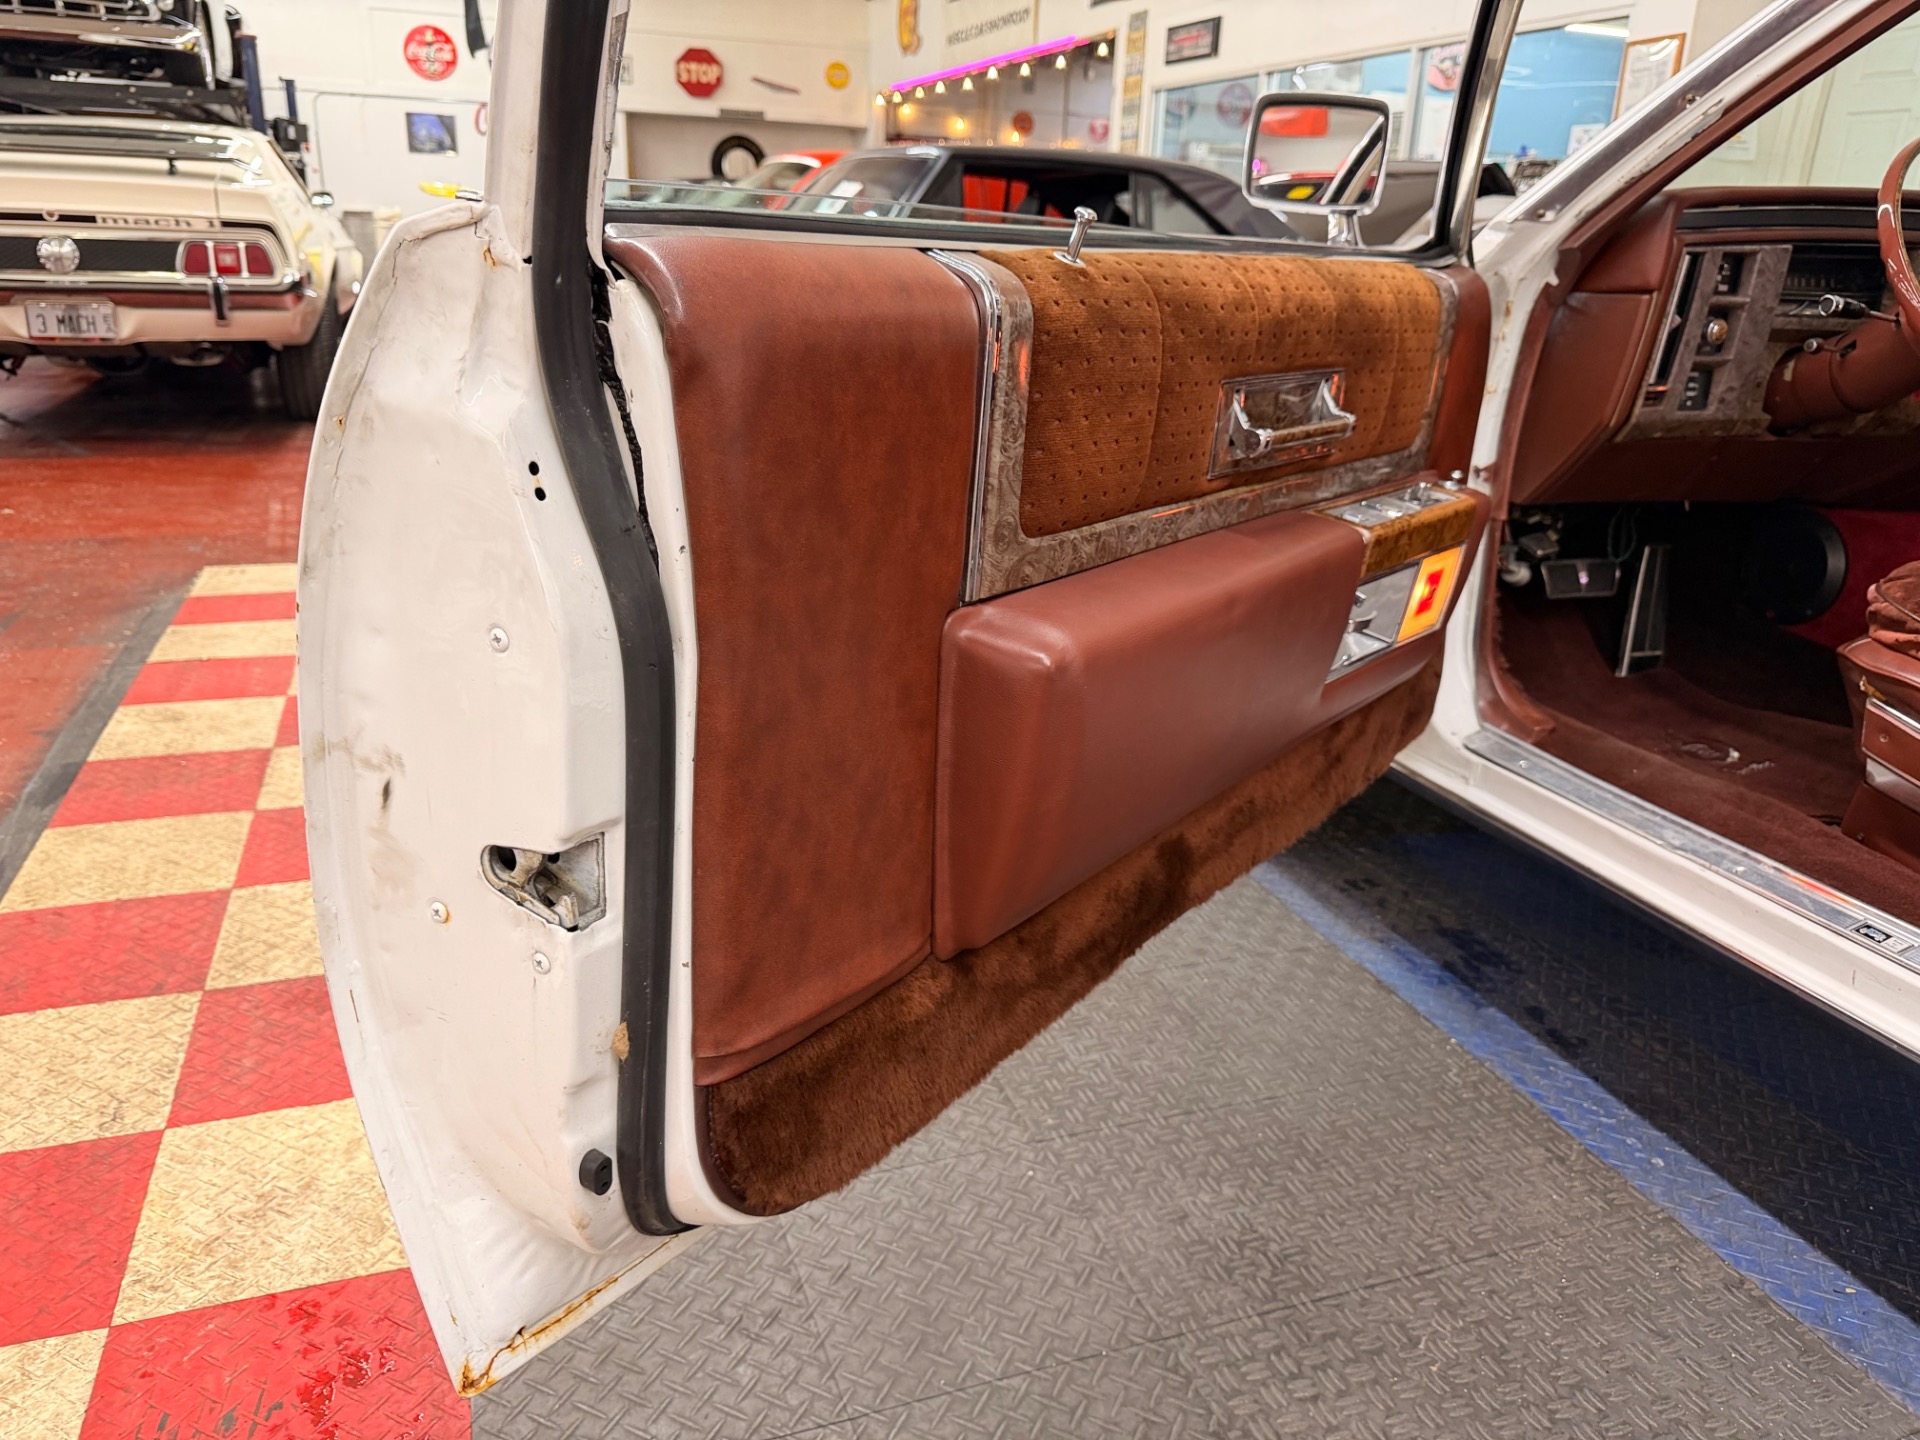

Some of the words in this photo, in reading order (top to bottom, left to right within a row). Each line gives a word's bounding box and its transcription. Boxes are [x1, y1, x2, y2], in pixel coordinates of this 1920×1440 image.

[678, 60, 721, 85] STOP
[100, 215, 192, 228] mach
[35, 314, 47, 334] 3
[56, 314, 97, 335] MACH
